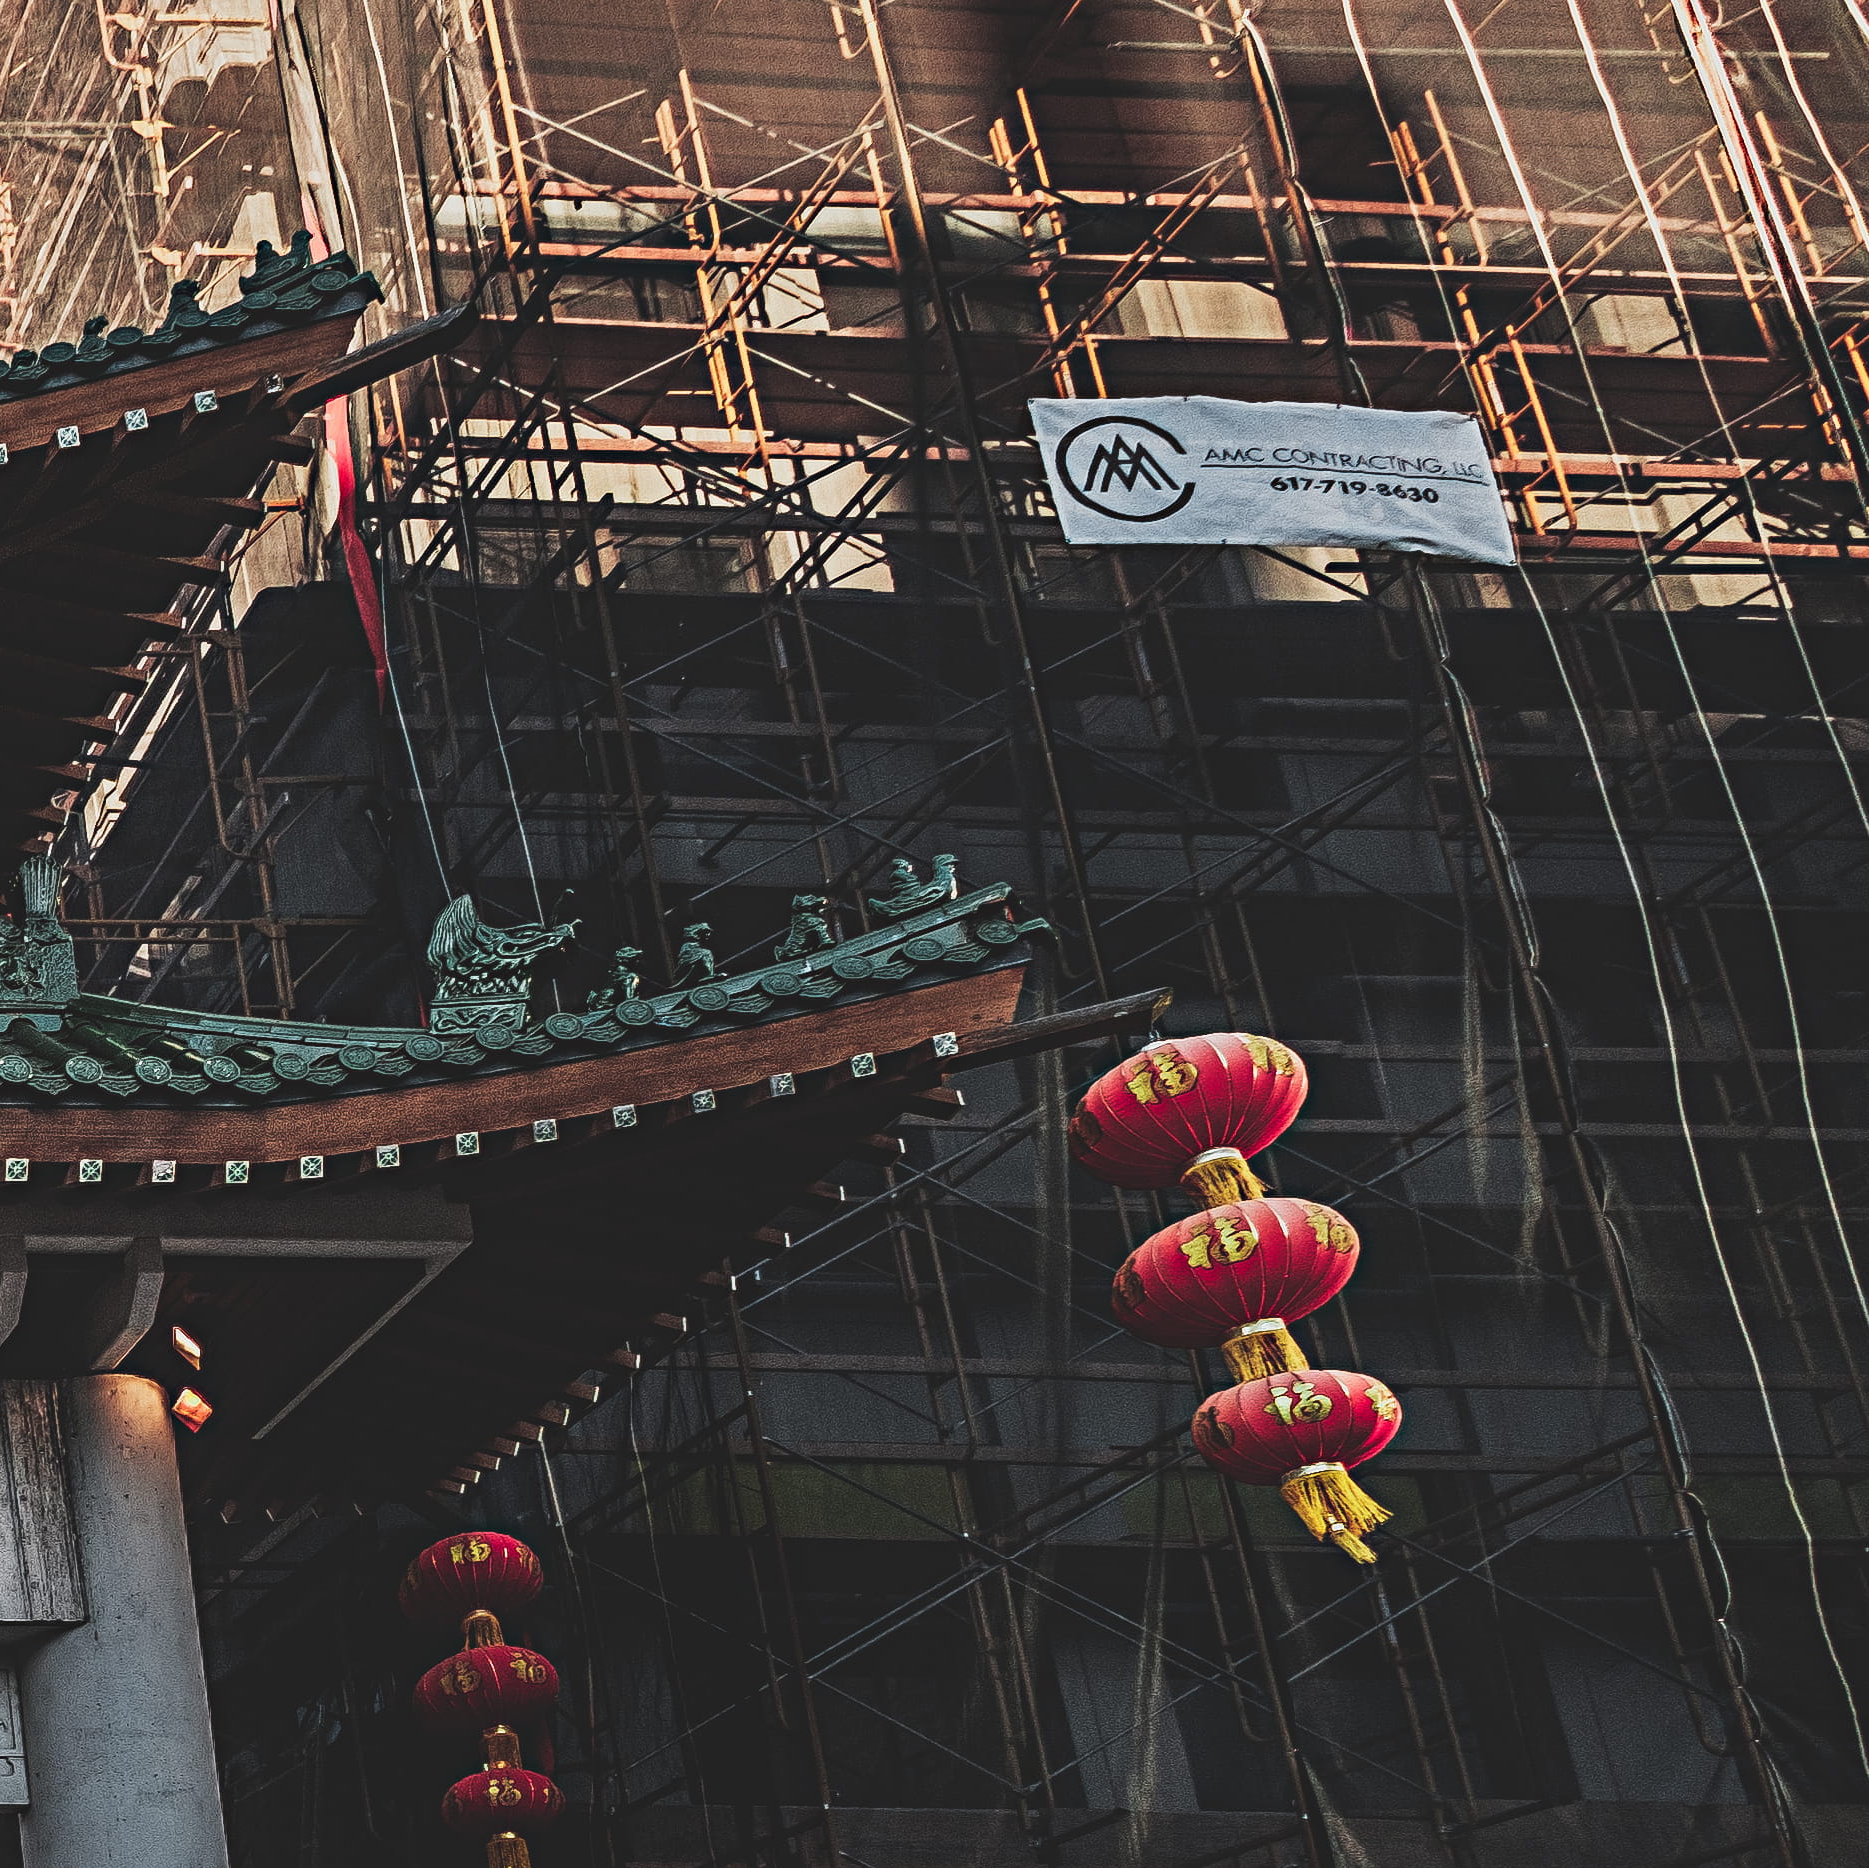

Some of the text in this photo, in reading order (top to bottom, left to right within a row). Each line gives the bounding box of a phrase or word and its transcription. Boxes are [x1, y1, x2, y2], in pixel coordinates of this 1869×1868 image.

[1205, 448, 1265, 462] AMC
[1272, 448, 1447, 475] CONTRACTING,
[1270, 476, 1440, 504] 617-719-8630
[1180, 1215, 1260, 1270] 福
